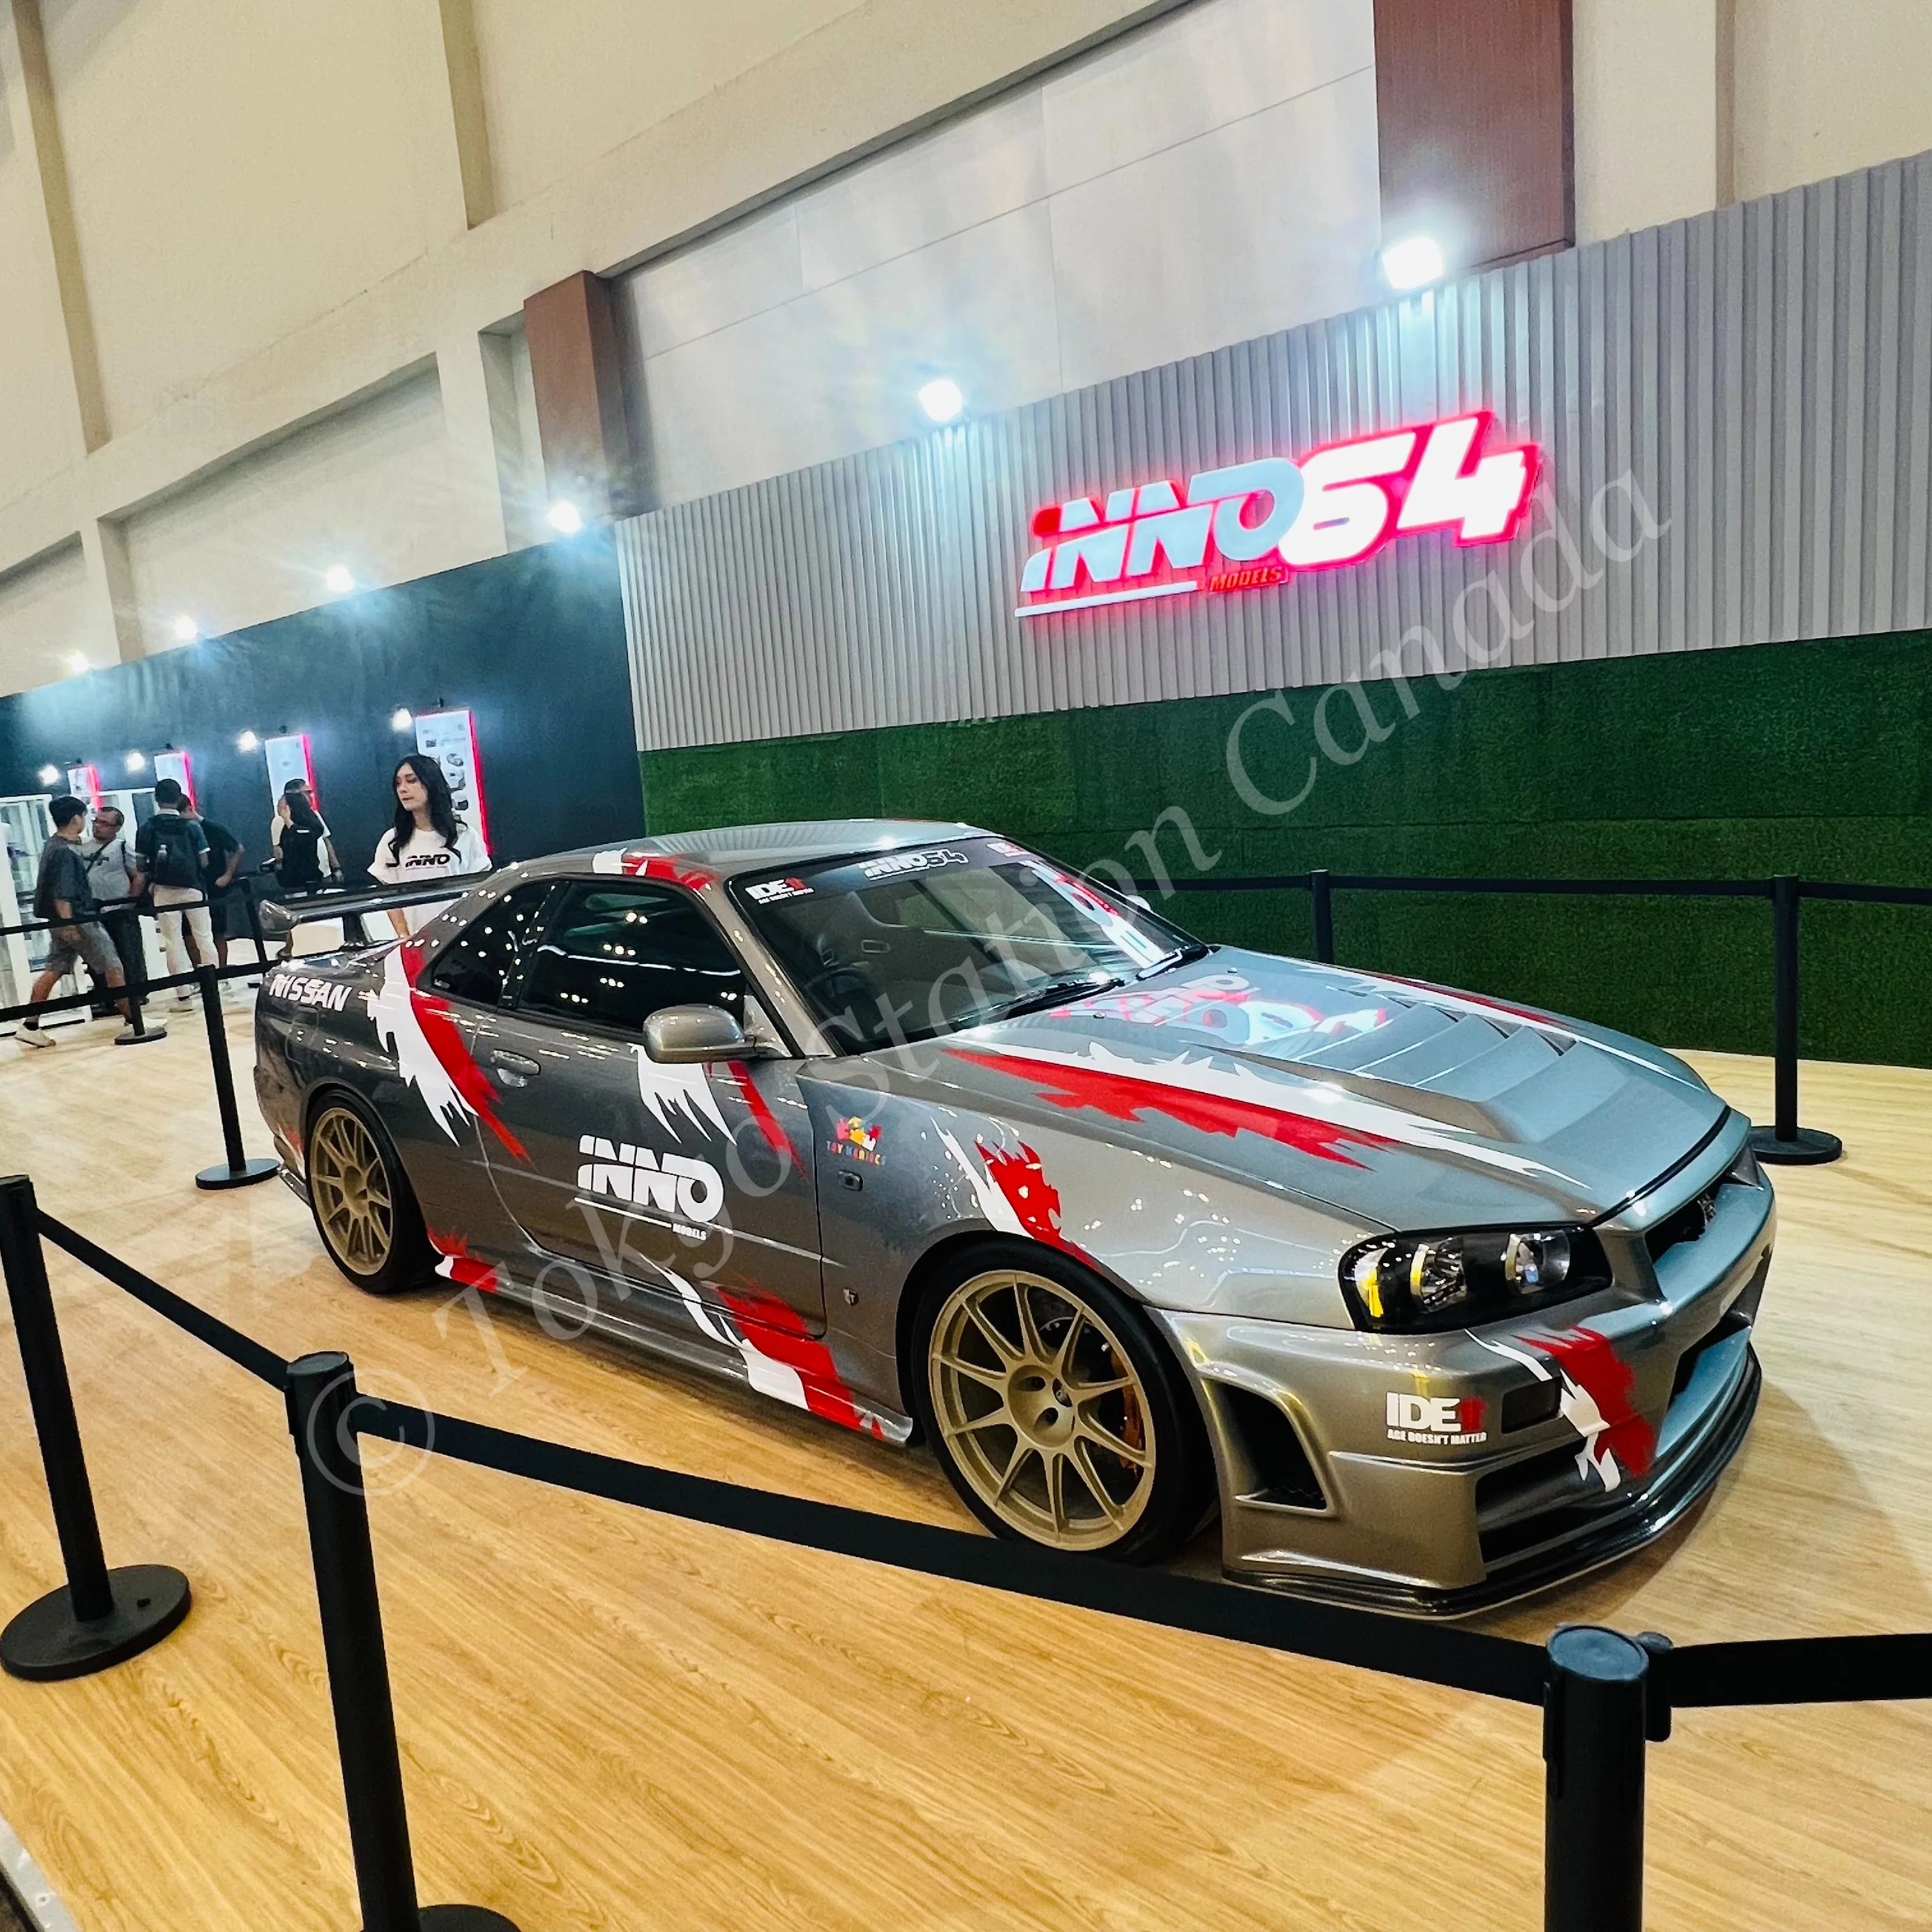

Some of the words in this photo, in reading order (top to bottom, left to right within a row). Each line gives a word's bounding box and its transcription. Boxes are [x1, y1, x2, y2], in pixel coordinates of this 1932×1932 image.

[1209, 566, 1283, 592] MODELS
[269, 974, 352, 1012] NISSAN
[578, 1135, 724, 1223] INNO
[1407, 1431, 1449, 1445] DOESN'T
